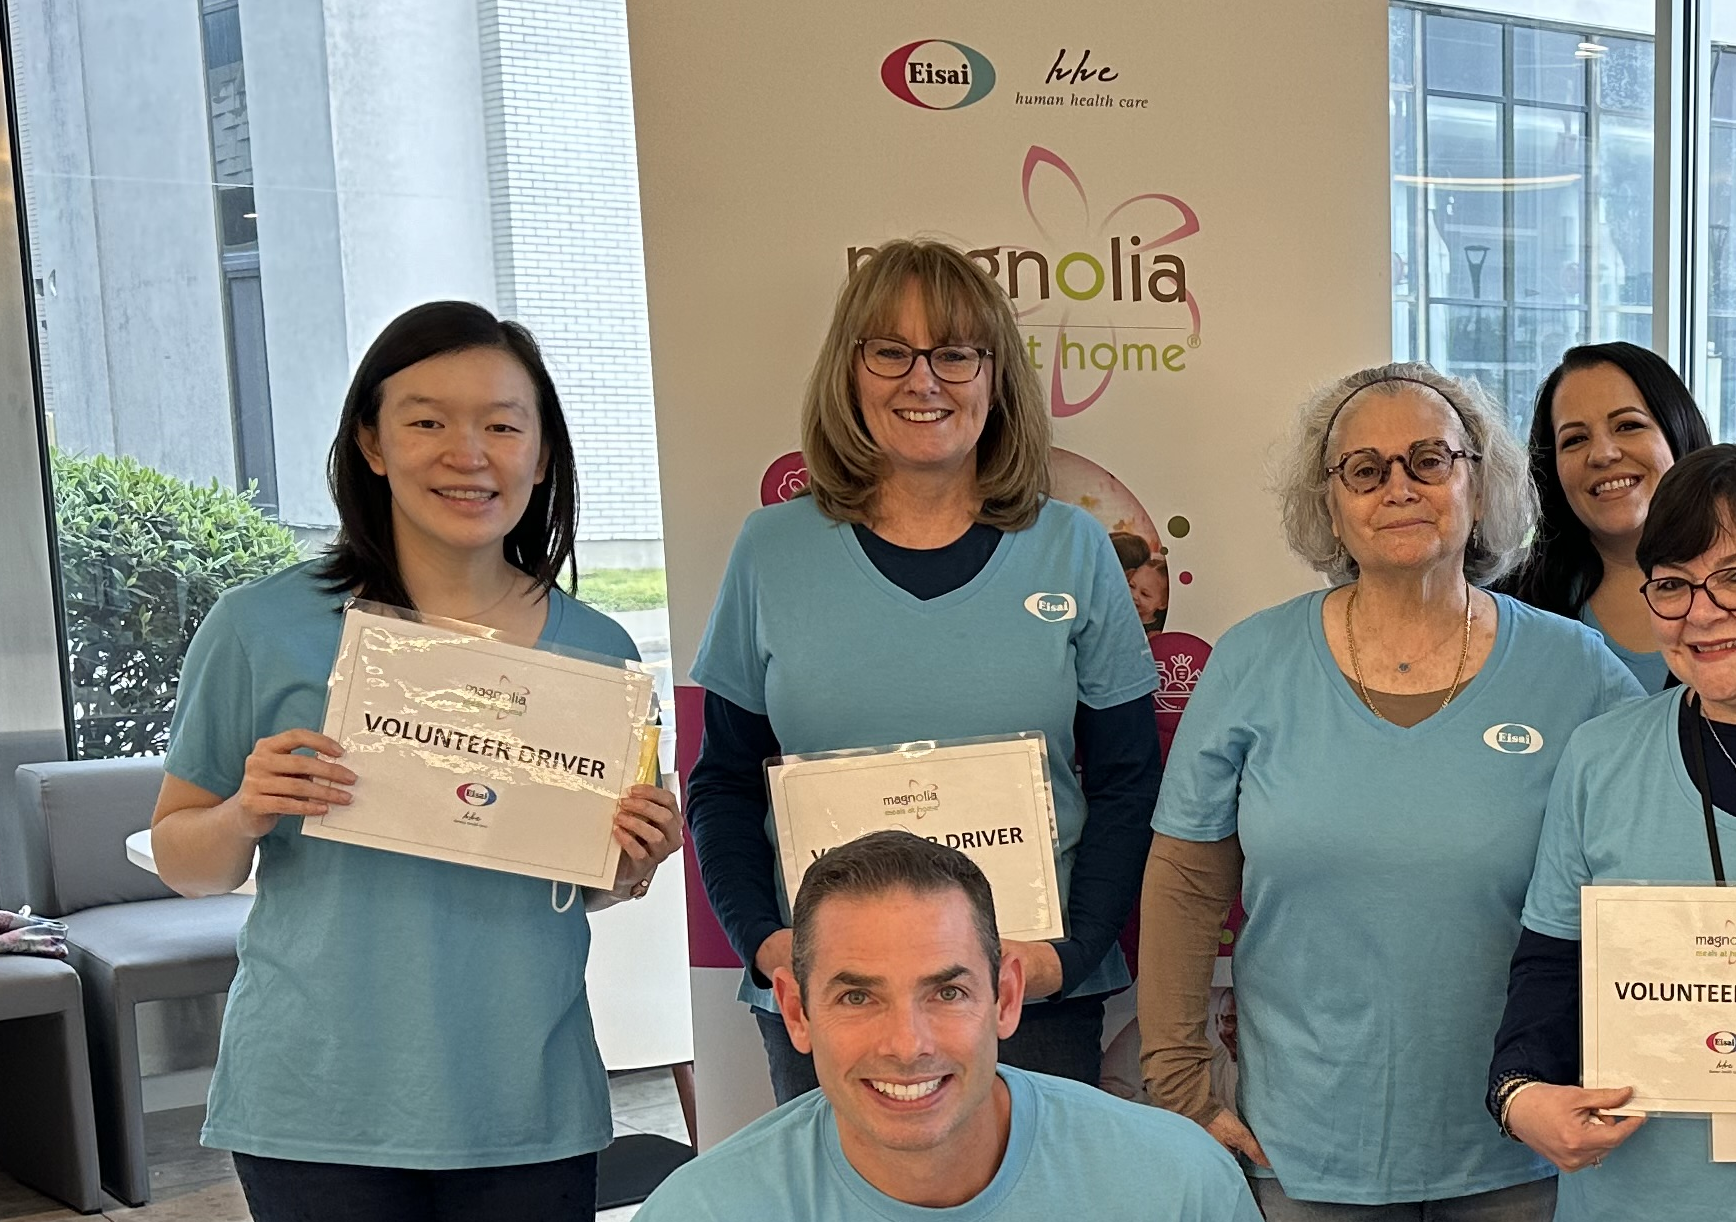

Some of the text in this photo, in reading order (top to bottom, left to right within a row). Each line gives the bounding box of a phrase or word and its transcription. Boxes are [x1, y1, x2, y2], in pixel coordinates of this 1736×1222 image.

[908, 62, 970, 85] Eisai
[1015, 92, 1148, 109] human health care
[847, 236, 1186, 302] nolia
[1027, 336, 1043, 368] t
[1039, 600, 1068, 611] Eisai
[364, 713, 606, 779] VOLUNTEER DRIVER
[1498, 732, 1531, 745] Eisai
[883, 790, 937, 805] magnolia
[946, 827, 1024, 850] DRIVER
